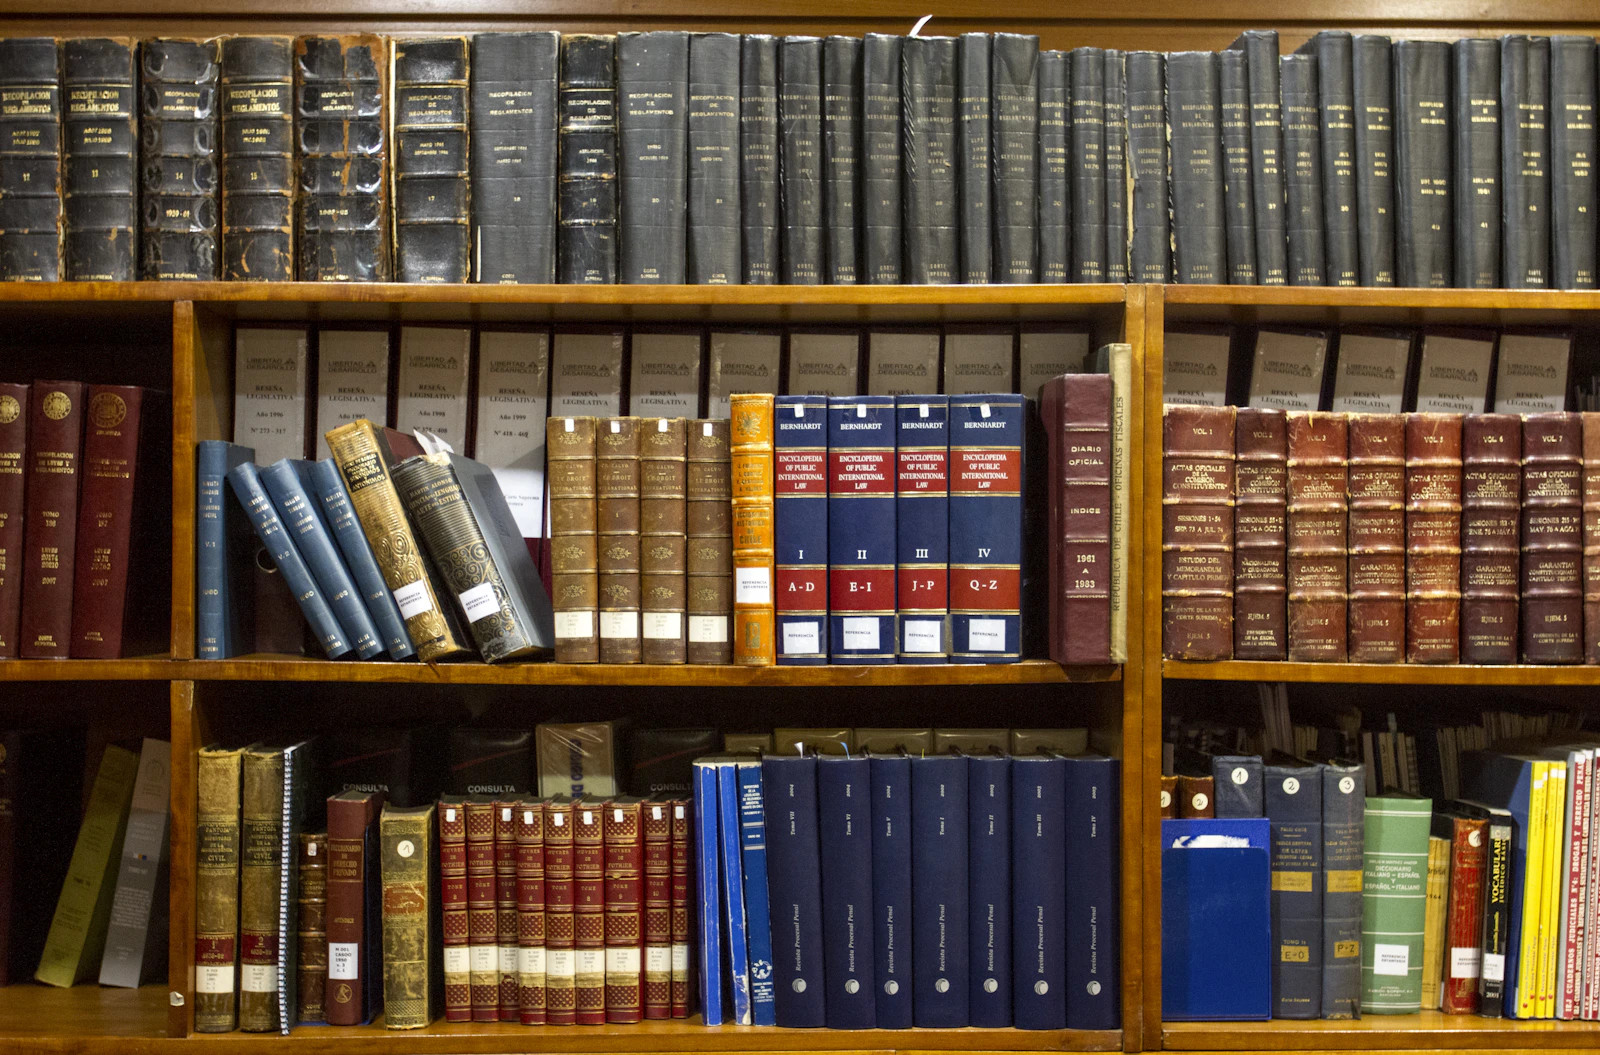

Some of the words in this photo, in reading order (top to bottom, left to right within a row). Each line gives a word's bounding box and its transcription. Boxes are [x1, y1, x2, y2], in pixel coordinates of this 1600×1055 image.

[176, 172, 183, 180] 14
[1114, 447, 1122, 491] OFICINAS
[839, 473, 884, 481] INTERNATIONAL
[432, 478, 452, 488] ALONSO
[1114, 503, 1122, 532] CHILE
[740, 535, 762, 544] CHILE
[1114, 537, 1121, 550] DE
[978, 549, 990, 557] IV
[1077, 555, 1095, 563] 1961
[789, 583, 796, 591] A
[806, 583, 814, 591] D
[850, 583, 857, 592] E
[867, 583, 872, 592] I
[912, 581, 917, 591] J
[927, 581, 934, 590] P
[970, 581, 979, 590] Q
[989, 581, 997, 589] Z
[1075, 580, 1095, 588] 1983
[343, 784, 389, 792] CONSULTA
[1288, 781, 1295, 791] 2
[1345, 781, 1351, 790] 3
[1575, 790, 1583, 826] DERECHO
[1572, 841, 1580, 872] DROGAS
[1569, 899, 1577, 943] JUDICIALES
[1566, 949, 1575, 993] CUADERNOS
